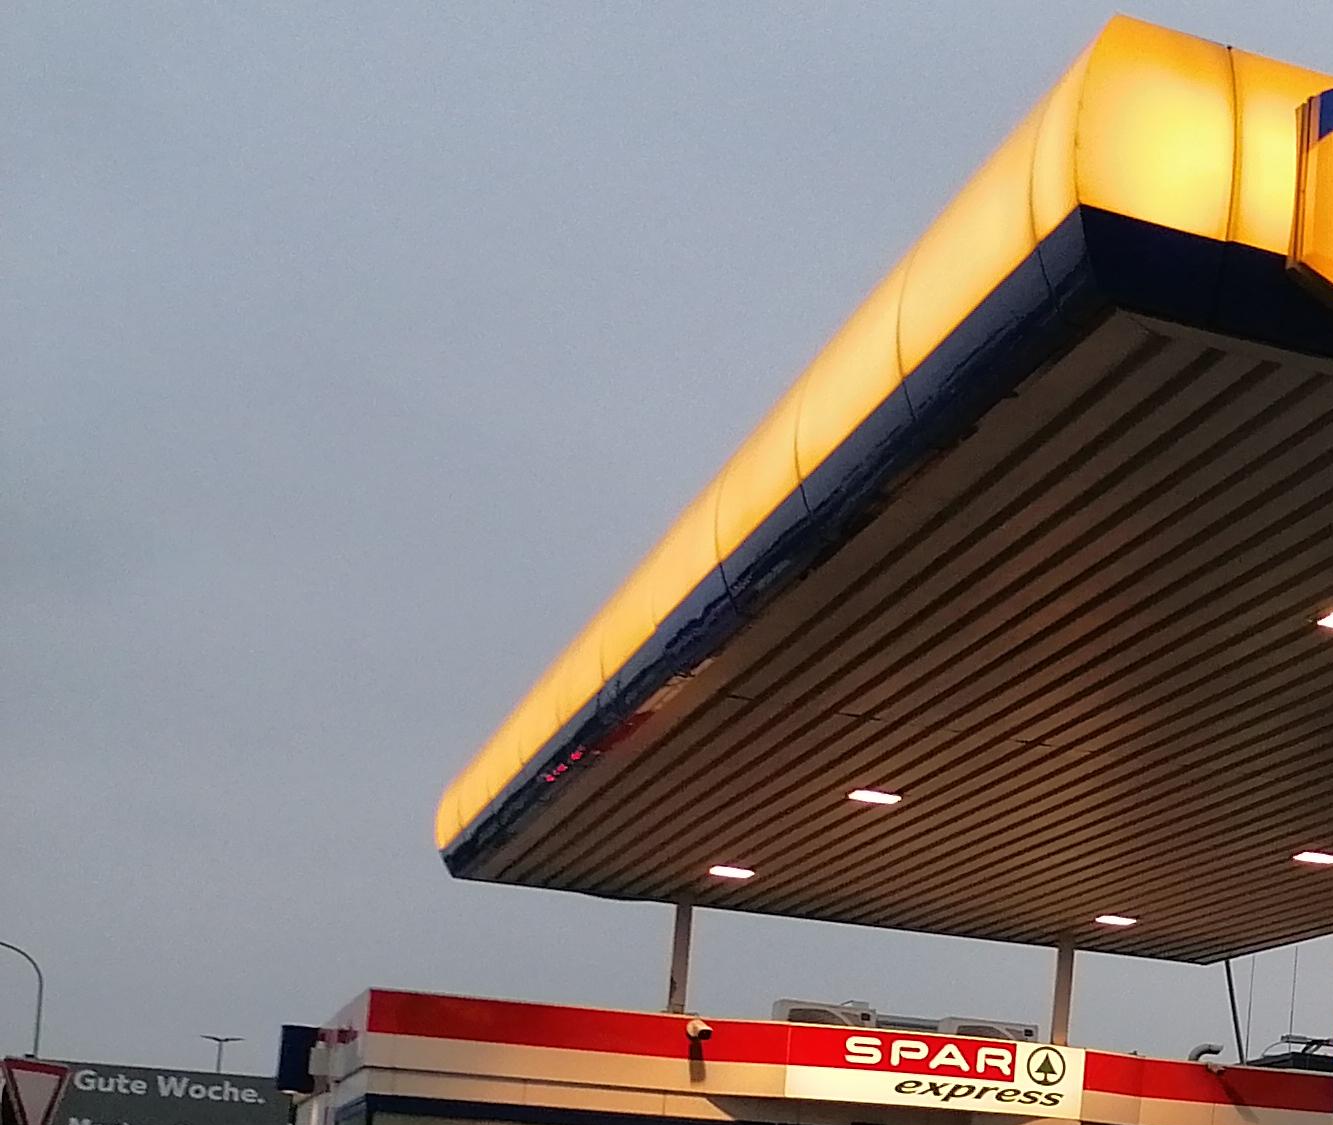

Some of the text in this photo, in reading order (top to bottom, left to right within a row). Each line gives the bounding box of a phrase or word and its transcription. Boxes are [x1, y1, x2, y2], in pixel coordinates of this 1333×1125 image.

[844, 1036, 1013, 1076] SPAR
[74, 1069, 266, 1104] Gute Woche.
[894, 1079, 1064, 1106] express
